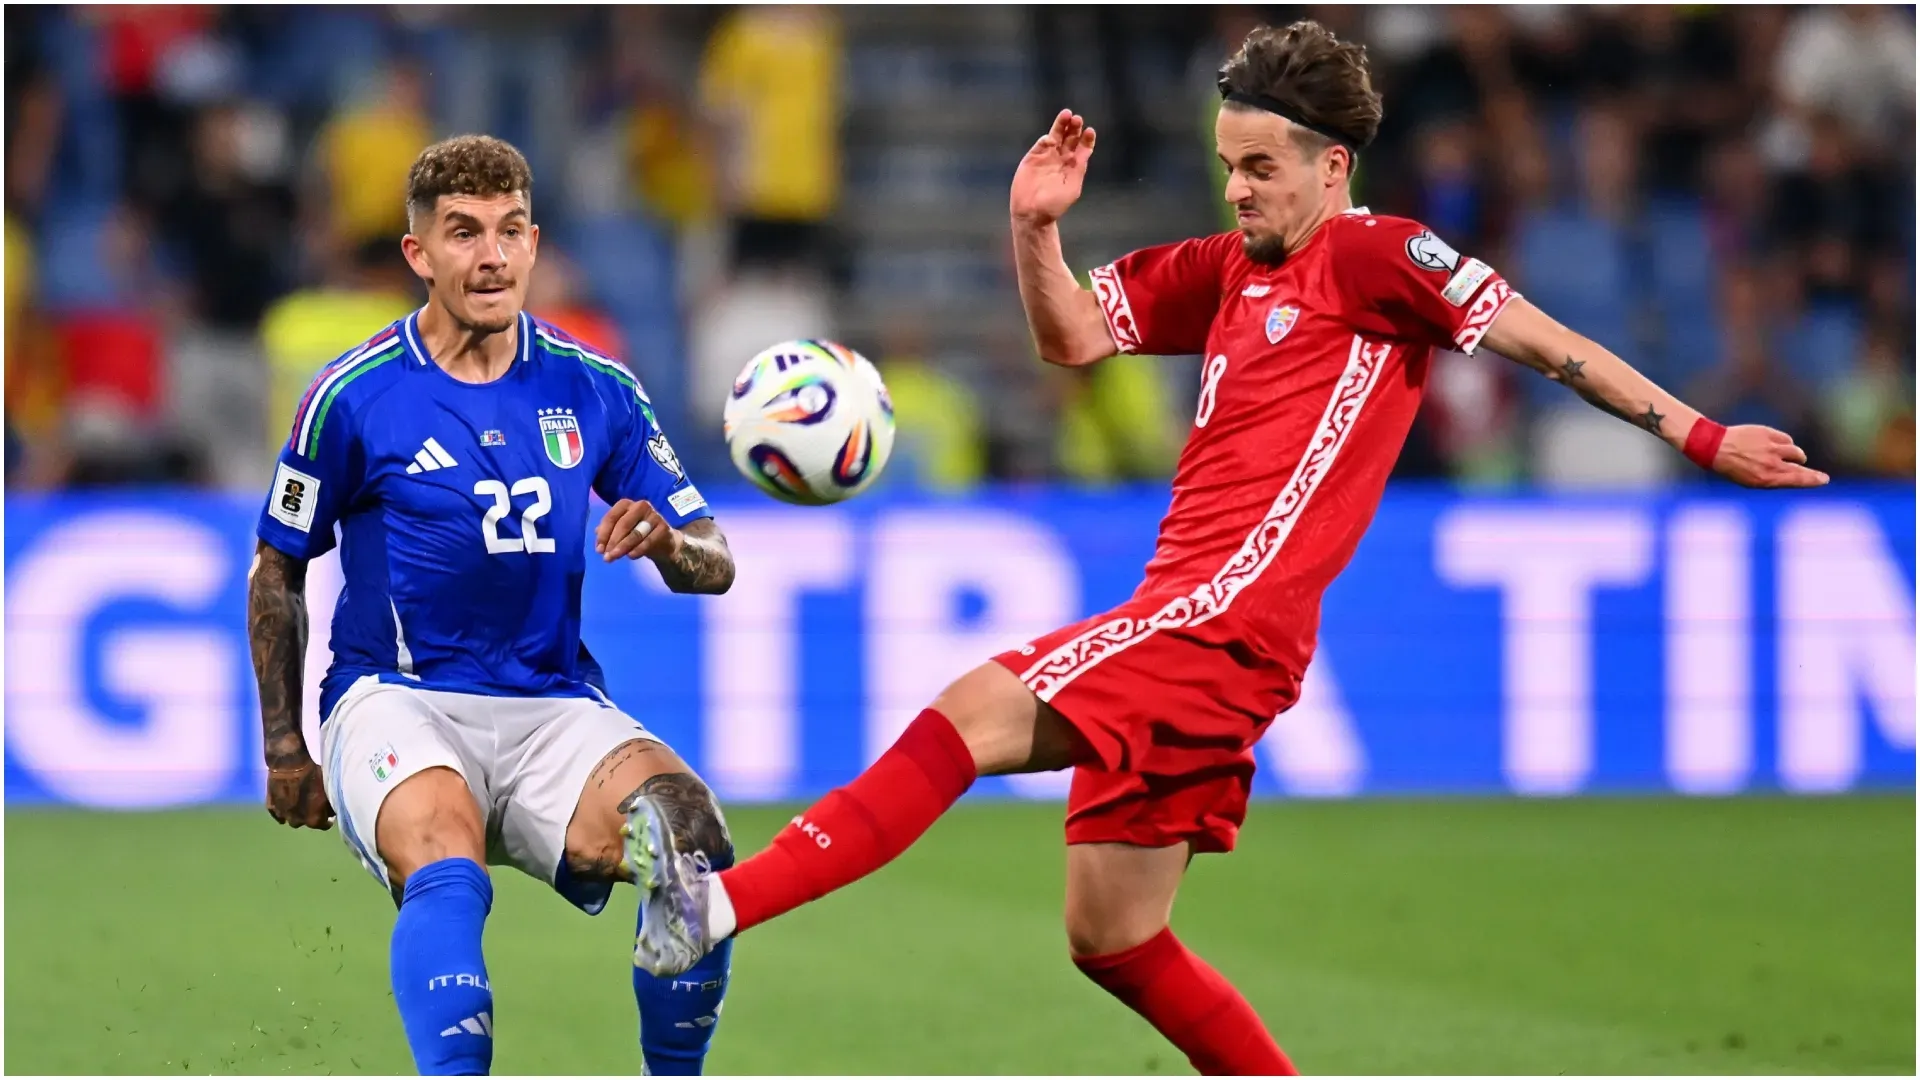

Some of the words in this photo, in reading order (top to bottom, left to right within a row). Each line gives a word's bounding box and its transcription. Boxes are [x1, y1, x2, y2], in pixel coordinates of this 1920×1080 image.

[1194, 352, 1228, 429] 8
[542, 418, 577, 431] ITALIA
[473, 476, 556, 554] 22
[790, 814, 832, 850] AKO
[429, 973, 492, 992] ITALI
